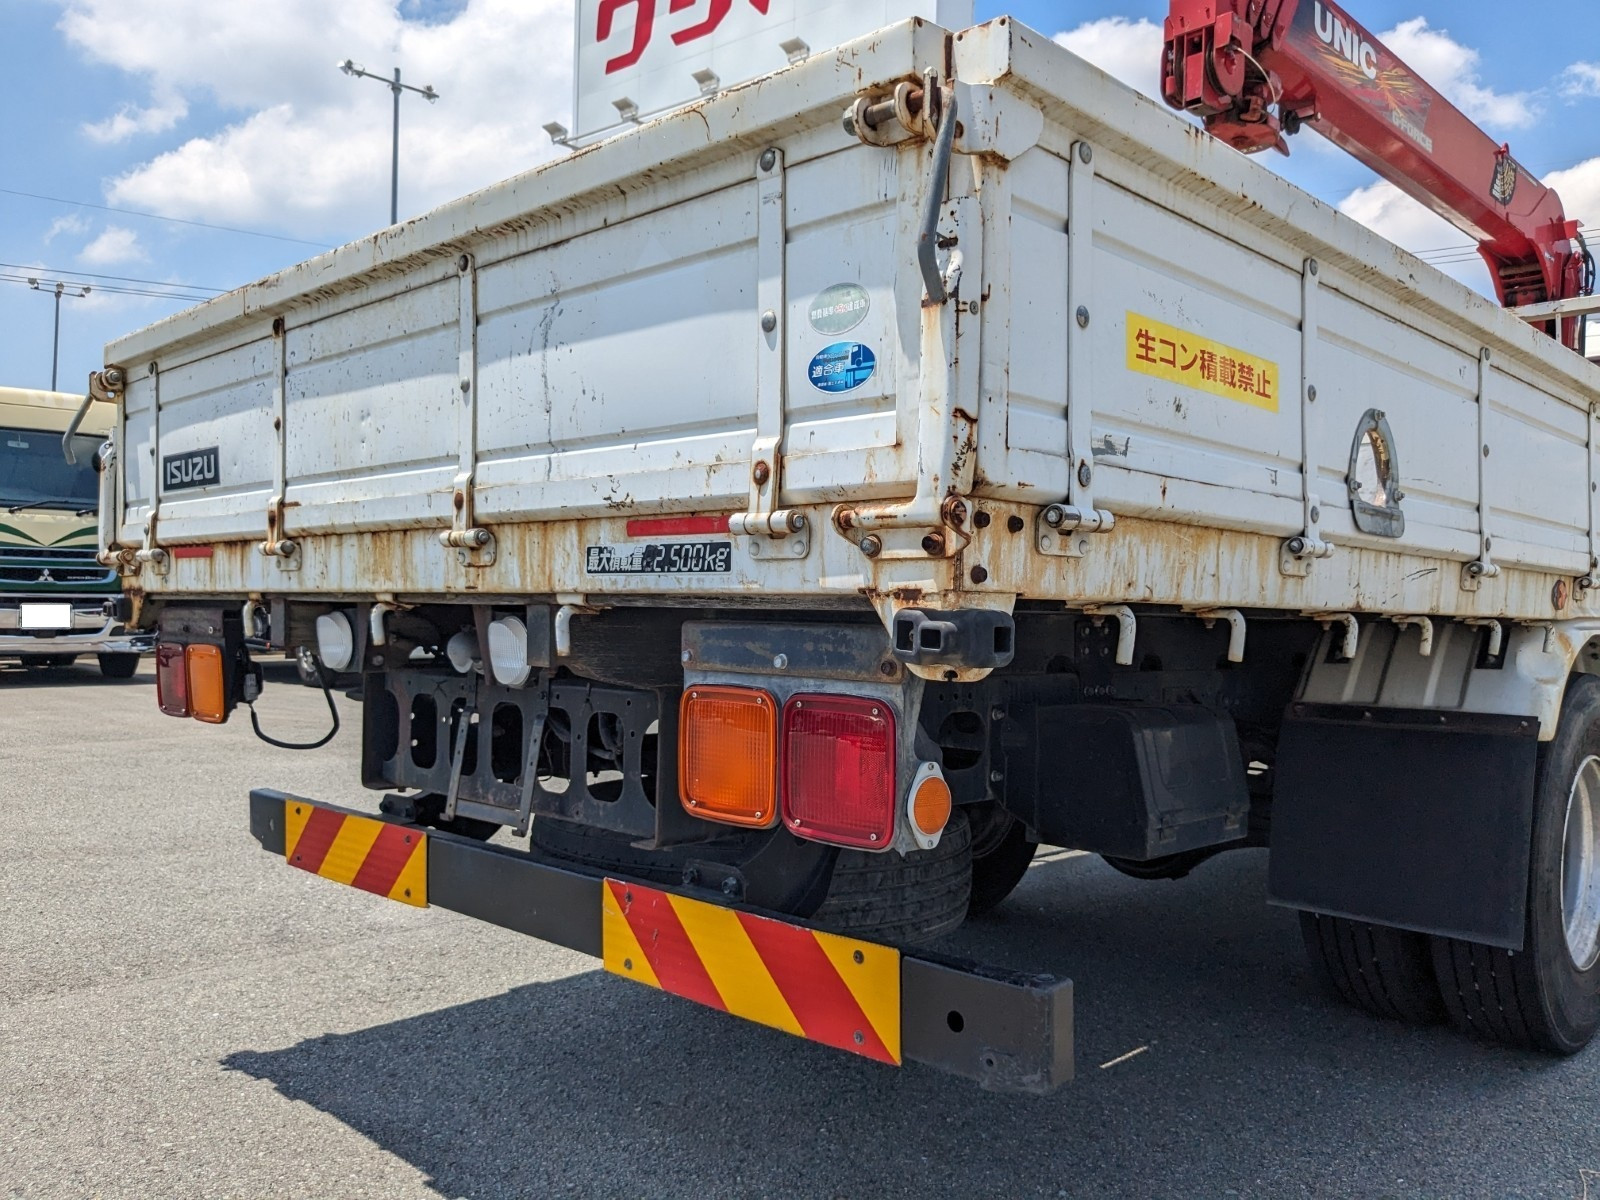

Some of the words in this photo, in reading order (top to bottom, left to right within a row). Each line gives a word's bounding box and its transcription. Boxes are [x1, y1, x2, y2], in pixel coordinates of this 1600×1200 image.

[1314, 0, 1377, 80] UNIC
[811, 362, 846, 378] 適合車
[1135, 328, 1272, 399] 生コン積載禁止
[166, 454, 215, 485] ISUZU
[653, 544, 730, 572] 2,500kg
